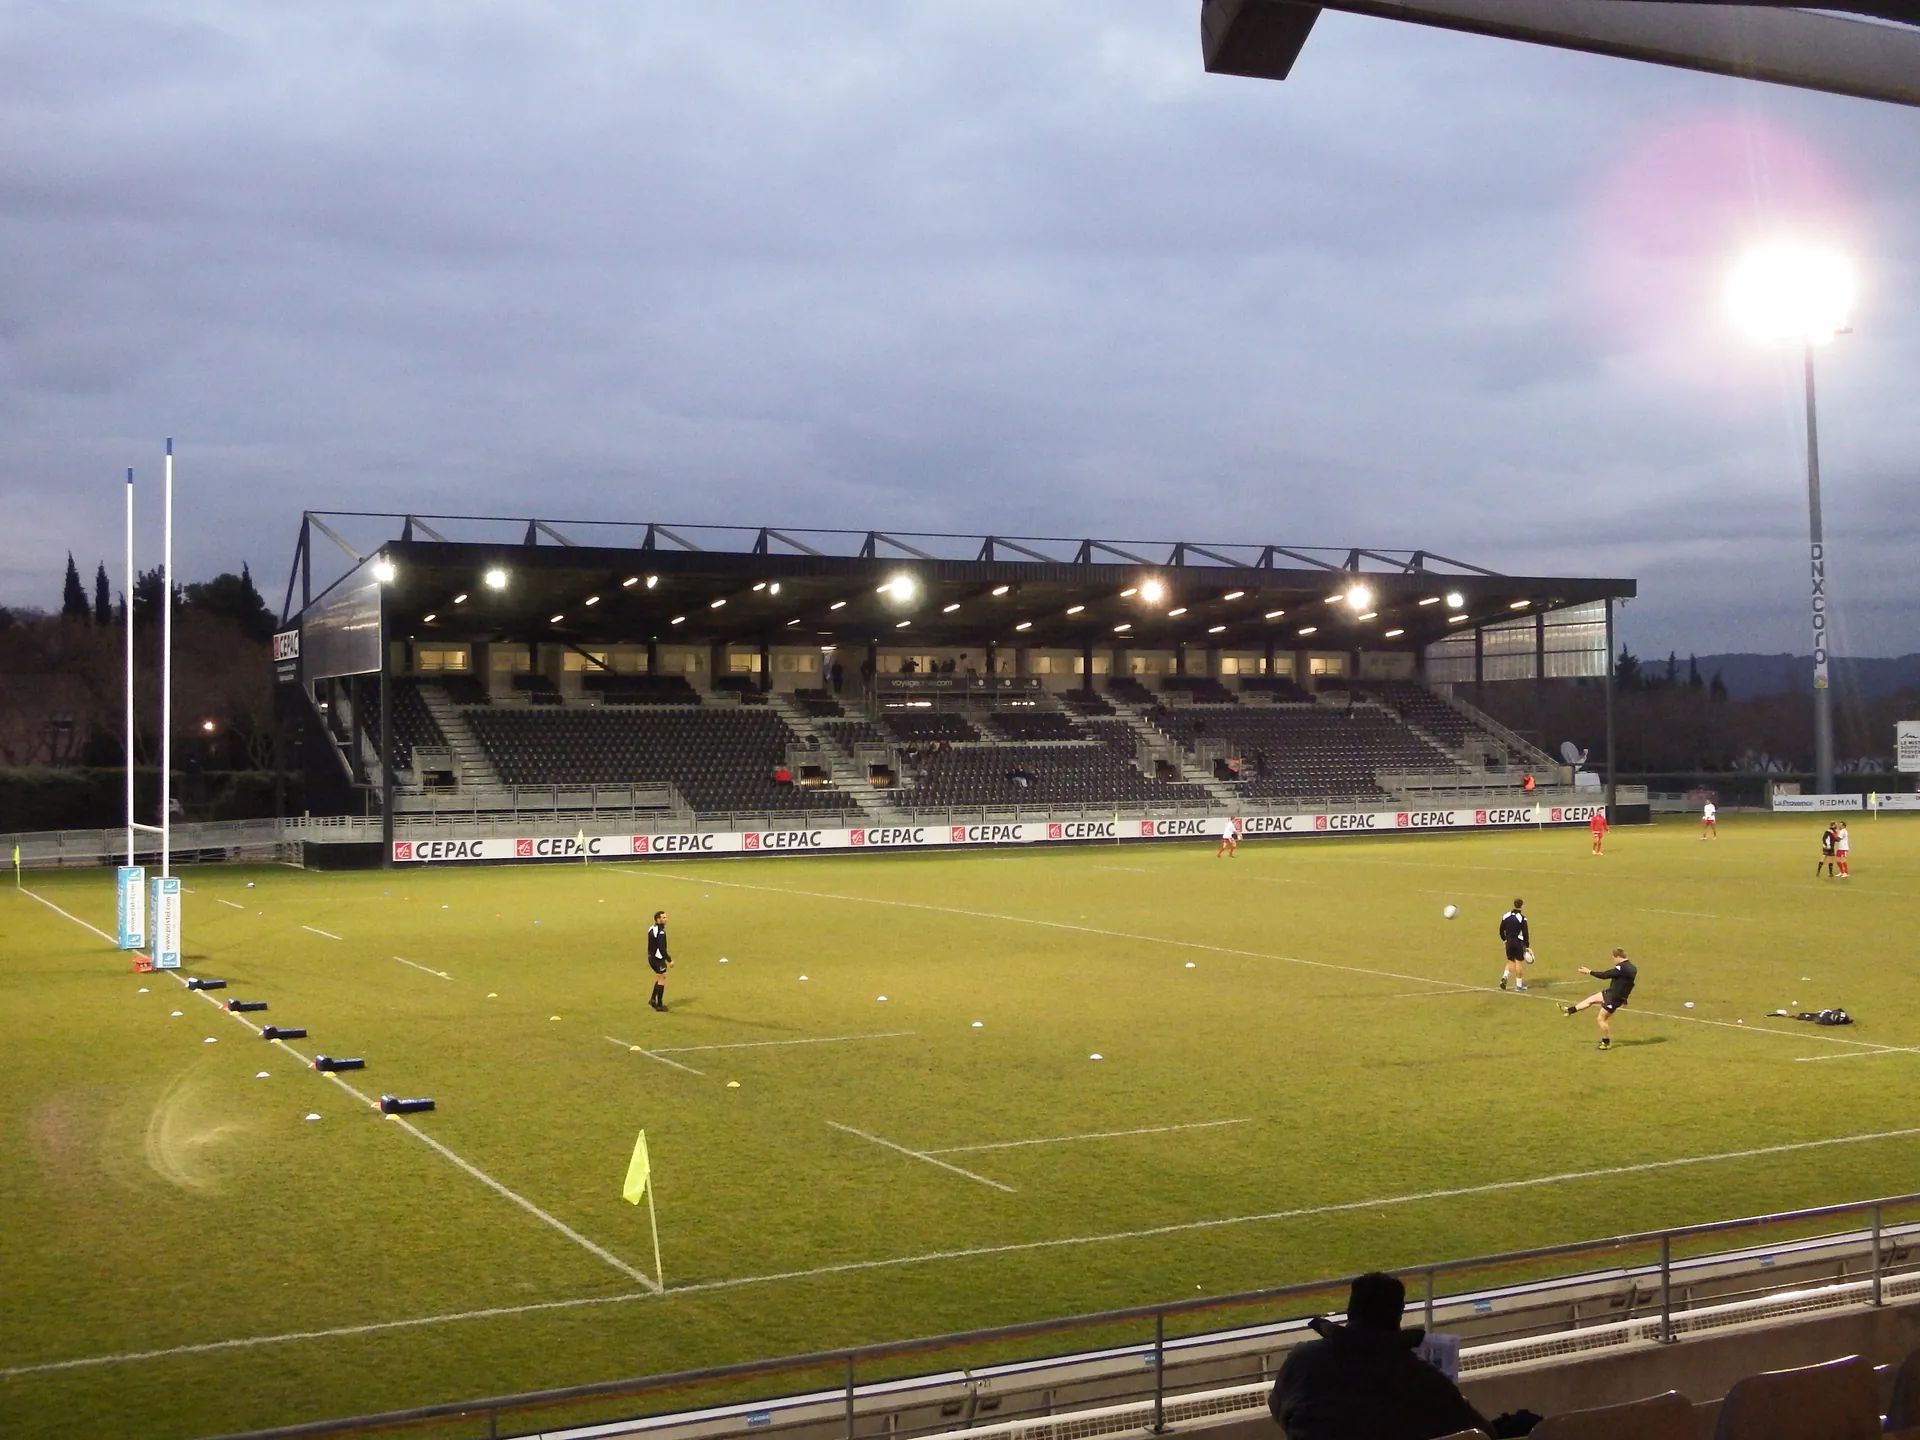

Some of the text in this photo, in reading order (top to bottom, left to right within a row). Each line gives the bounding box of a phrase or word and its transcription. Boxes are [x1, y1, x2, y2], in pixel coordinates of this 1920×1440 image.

[280, 632, 298, 657] CEPAC
[1819, 799, 1858, 807] REDMAN
[1245, 816, 1293, 832] CEPAC
[1329, 814, 1375, 829] CEPAC
[1410, 811, 1455, 827] CEPAC
[1488, 809, 1531, 823] CEPAC
[968, 825, 1022, 841] CEPAC
[1064, 822, 1116, 837] CEPAC
[1156, 819, 1206, 835] CEPAC
[652, 834, 714, 852] CEPAC
[762, 830, 822, 848] CEPAC
[868, 827, 924, 844] CEPAC
[415, 840, 483, 859] CEPAC
[537, 837, 601, 856] CEPAC
